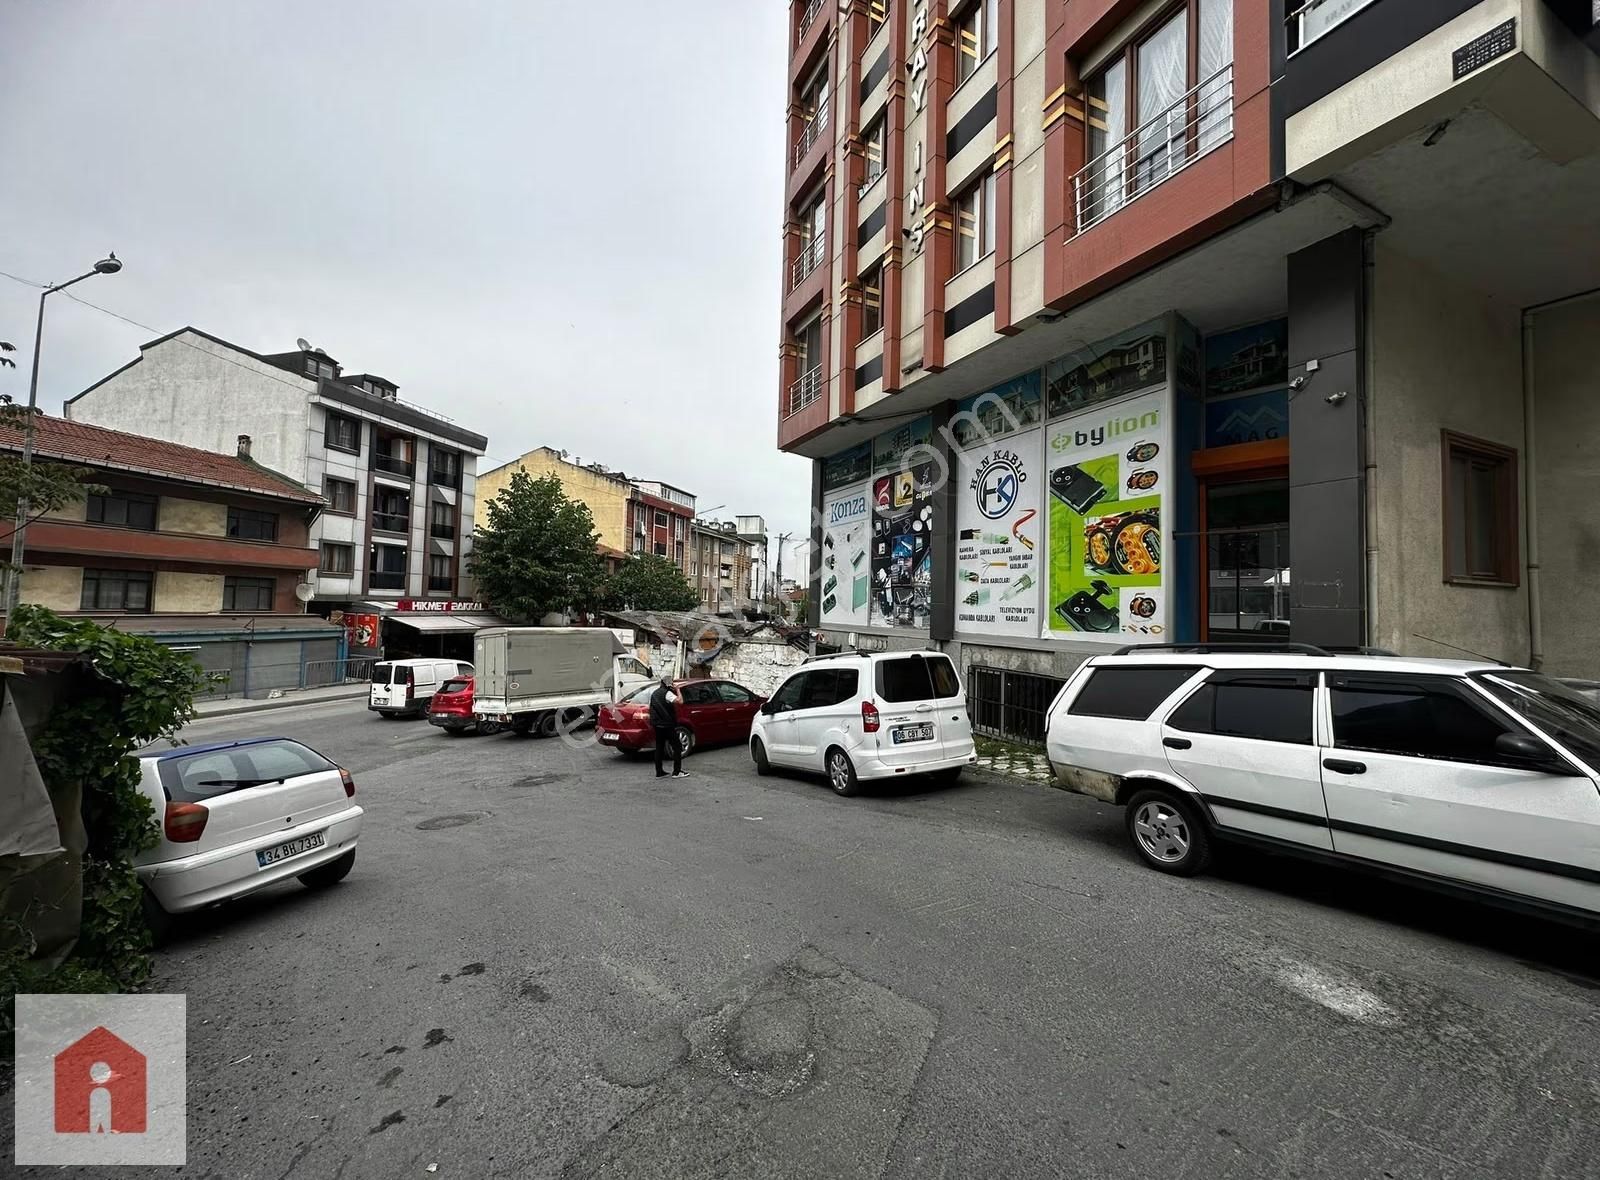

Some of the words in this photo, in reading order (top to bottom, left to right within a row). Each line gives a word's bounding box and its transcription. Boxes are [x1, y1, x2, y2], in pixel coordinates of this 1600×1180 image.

[911, 0, 928, 113] RAY
[1074, 410, 1158, 447] bylion
[970, 455, 990, 490] HAN
[993, 450, 1027, 483] KABLO
[830, 496, 867, 523] Konza
[266, 849, 280, 861] 34
[283, 844, 297, 856] BH
[299, 834, 322, 851] 7331
